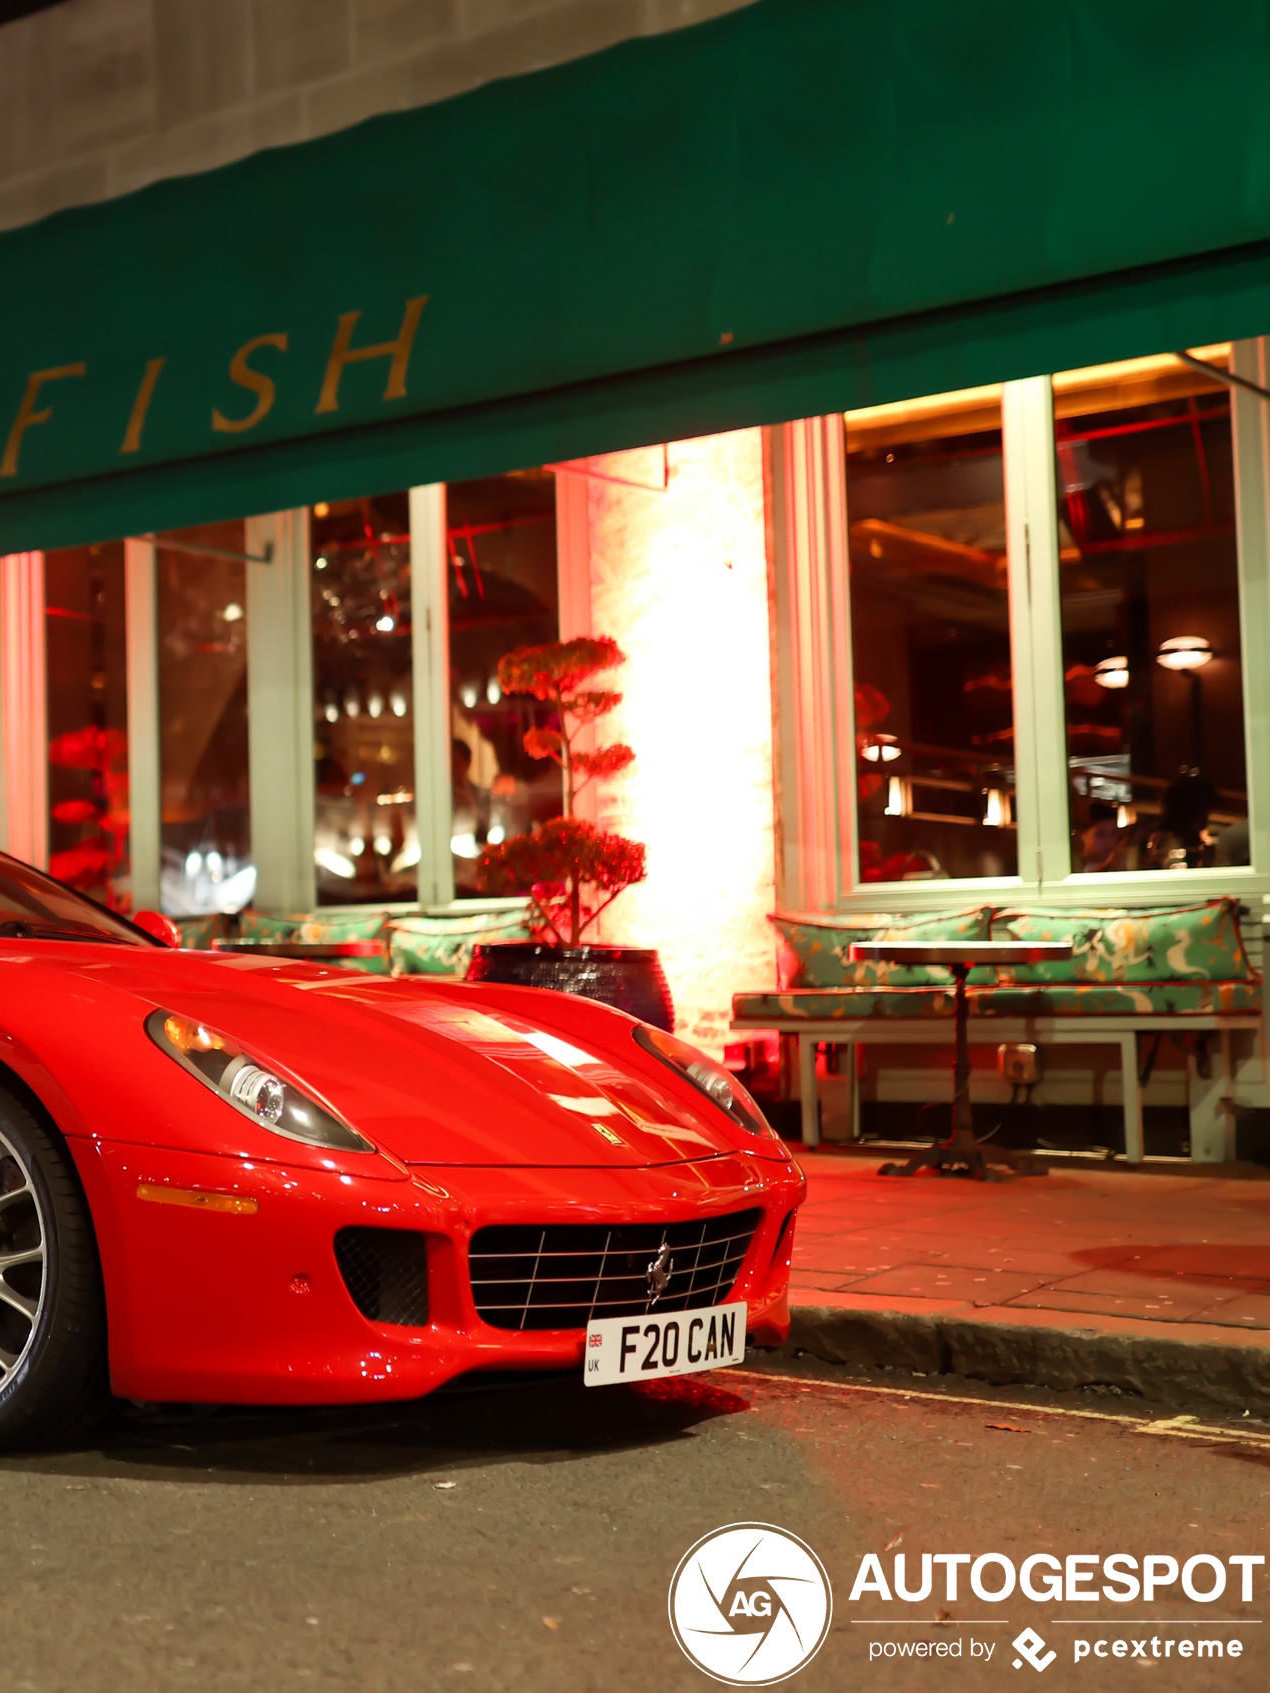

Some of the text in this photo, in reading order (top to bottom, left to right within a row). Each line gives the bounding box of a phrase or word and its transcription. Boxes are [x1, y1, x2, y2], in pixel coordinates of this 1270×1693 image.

[619, 1311, 736, 1373] F20 CAN
[588, 1359, 600, 1372] UK
